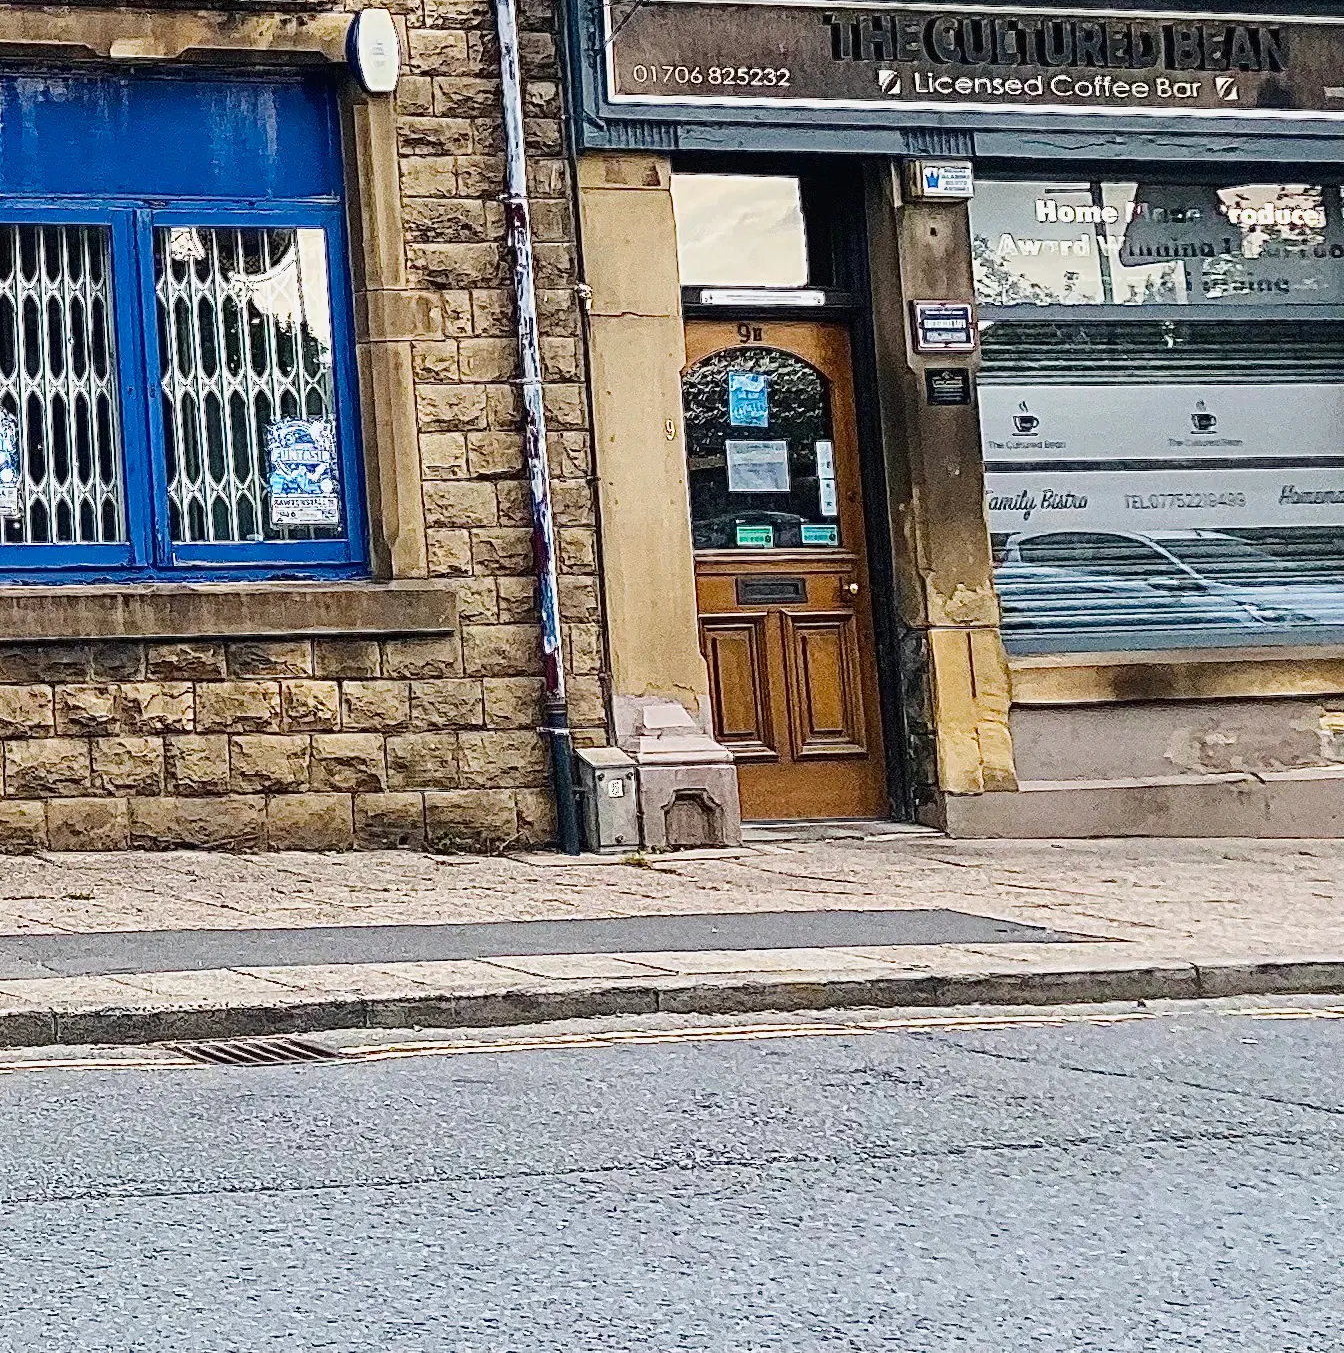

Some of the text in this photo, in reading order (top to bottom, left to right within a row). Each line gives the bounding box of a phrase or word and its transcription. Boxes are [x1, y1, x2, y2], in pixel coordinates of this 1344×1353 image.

[823, 11, 1291, 72] THE CULTURED BEAN
[633, 64, 791, 87] 01706 825232
[914, 73, 1202, 99] Licensed Coffee Bar
[1035, 199, 1119, 224] Home
[996, 233, 1091, 257] Award
[986, 488, 1088, 520] amily Bistro
